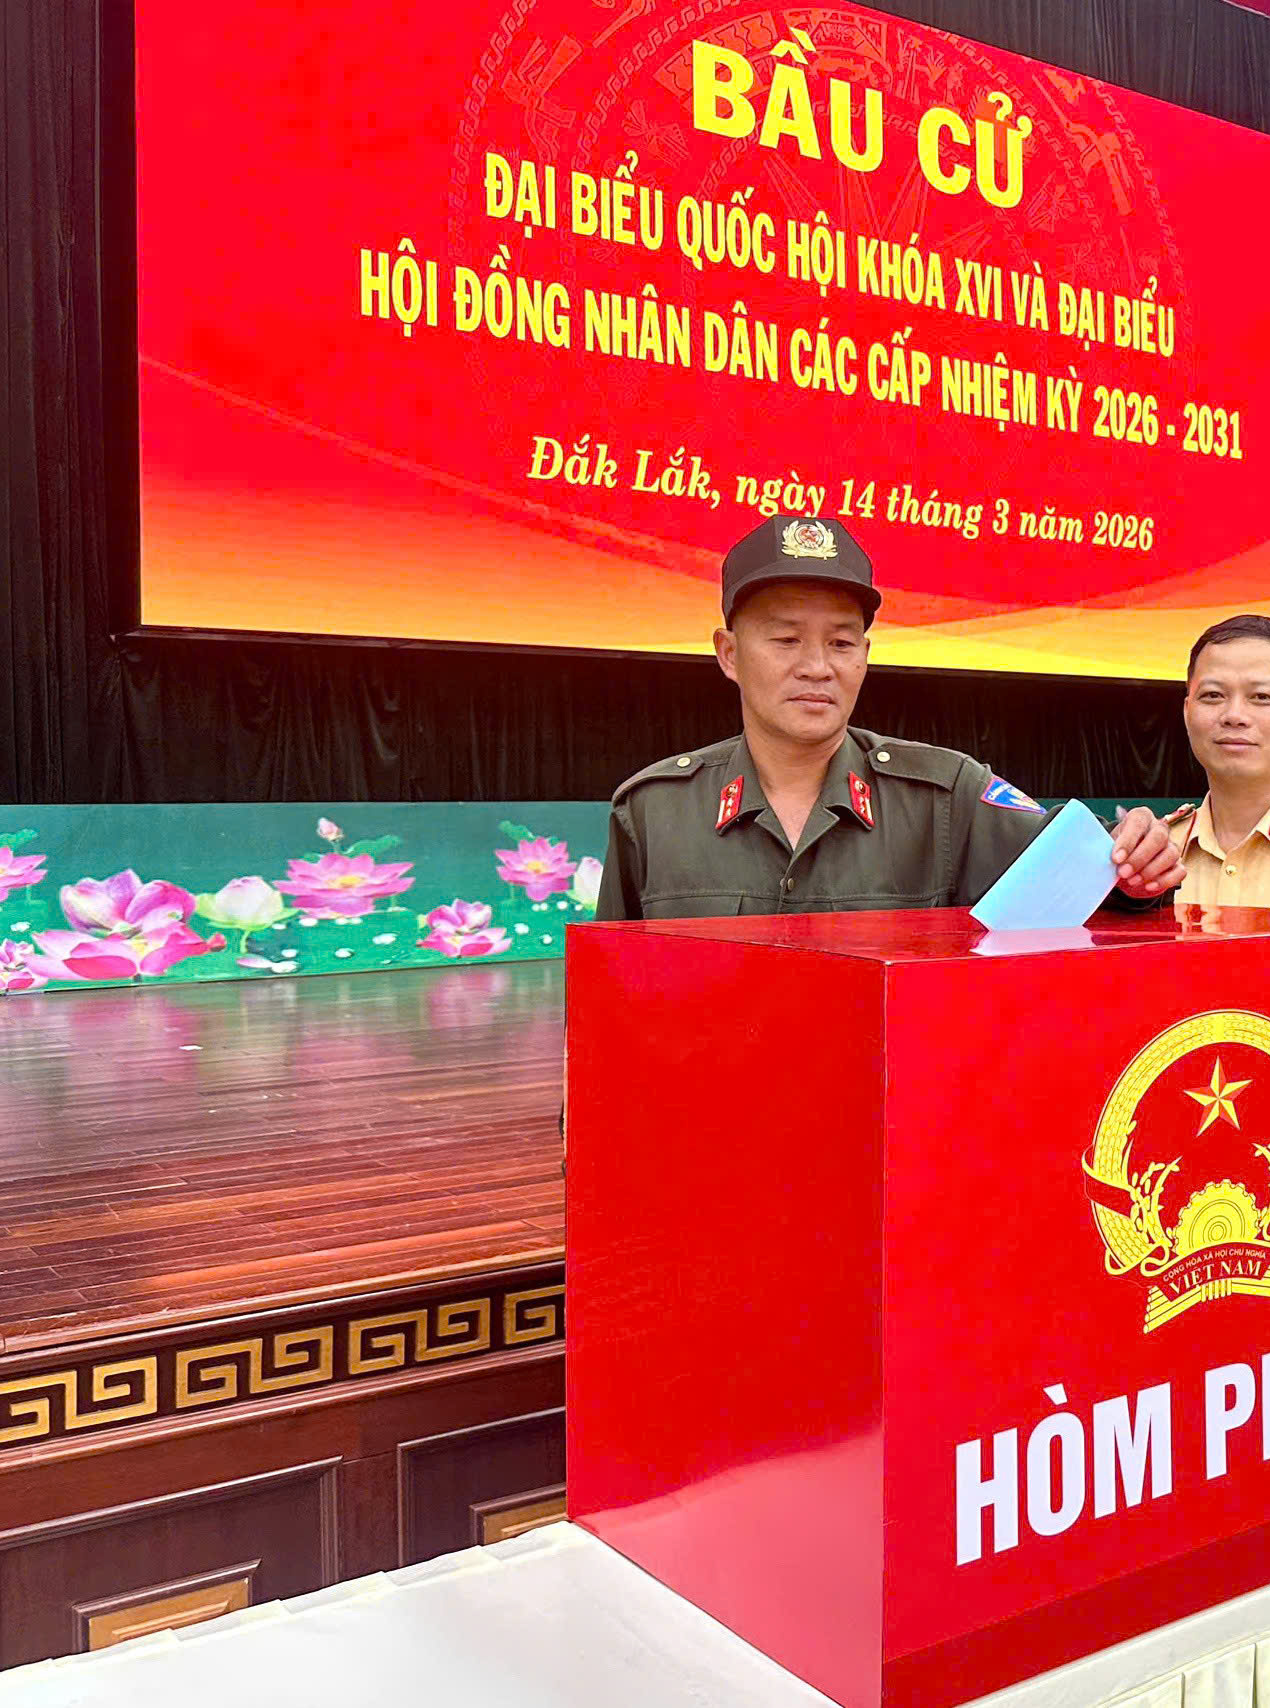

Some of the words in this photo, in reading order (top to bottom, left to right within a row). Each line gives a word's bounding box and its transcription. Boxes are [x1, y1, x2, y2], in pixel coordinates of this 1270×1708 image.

[692, 26, 884, 173] BẦU
[917, 91, 1033, 209] CỬ
[484, 152, 556, 239] ĐẠI
[571, 150, 664, 251] BIỂU
[676, 186, 776, 274] QUỐC
[787, 210, 846, 297] HỘI
[857, 232, 946, 310] KHÓA
[954, 257, 1003, 321] XVI
[1010, 261, 1049, 332] VÀ
[1058, 282, 1105, 352] ĐẠI
[1113, 275, 1175, 358] BIỂU
[360, 237, 438, 337] HỘI
[452, 244, 571, 349] ĐỒNG
[584, 283, 691, 368] NHÂN
[704, 300, 779, 382] DÂN
[789, 317, 858, 396] CÁC
[867, 326, 932, 407] CẤP
[941, 351, 1037, 432] NHIỆM
[1046, 365, 1083, 433] KỲ
[1093, 385, 1159, 446] 2026
[1166, 424, 1176, 436] -
[1183, 402, 1243, 460] 2031
[527, 433, 618, 489] Đắk
[631, 446, 721, 510] Lắk,
[735, 470, 826, 519] ngày
[837, 479, 876, 518] 14
[886, 484, 984, 540] tháng
[992, 498, 1010, 535] 3
[1019, 506, 1084, 544] năm
[1092, 511, 1154, 551] 2026
[1219, 1259, 1262, 1276] NAM
[956, 1383, 1173, 1566] HÒM
